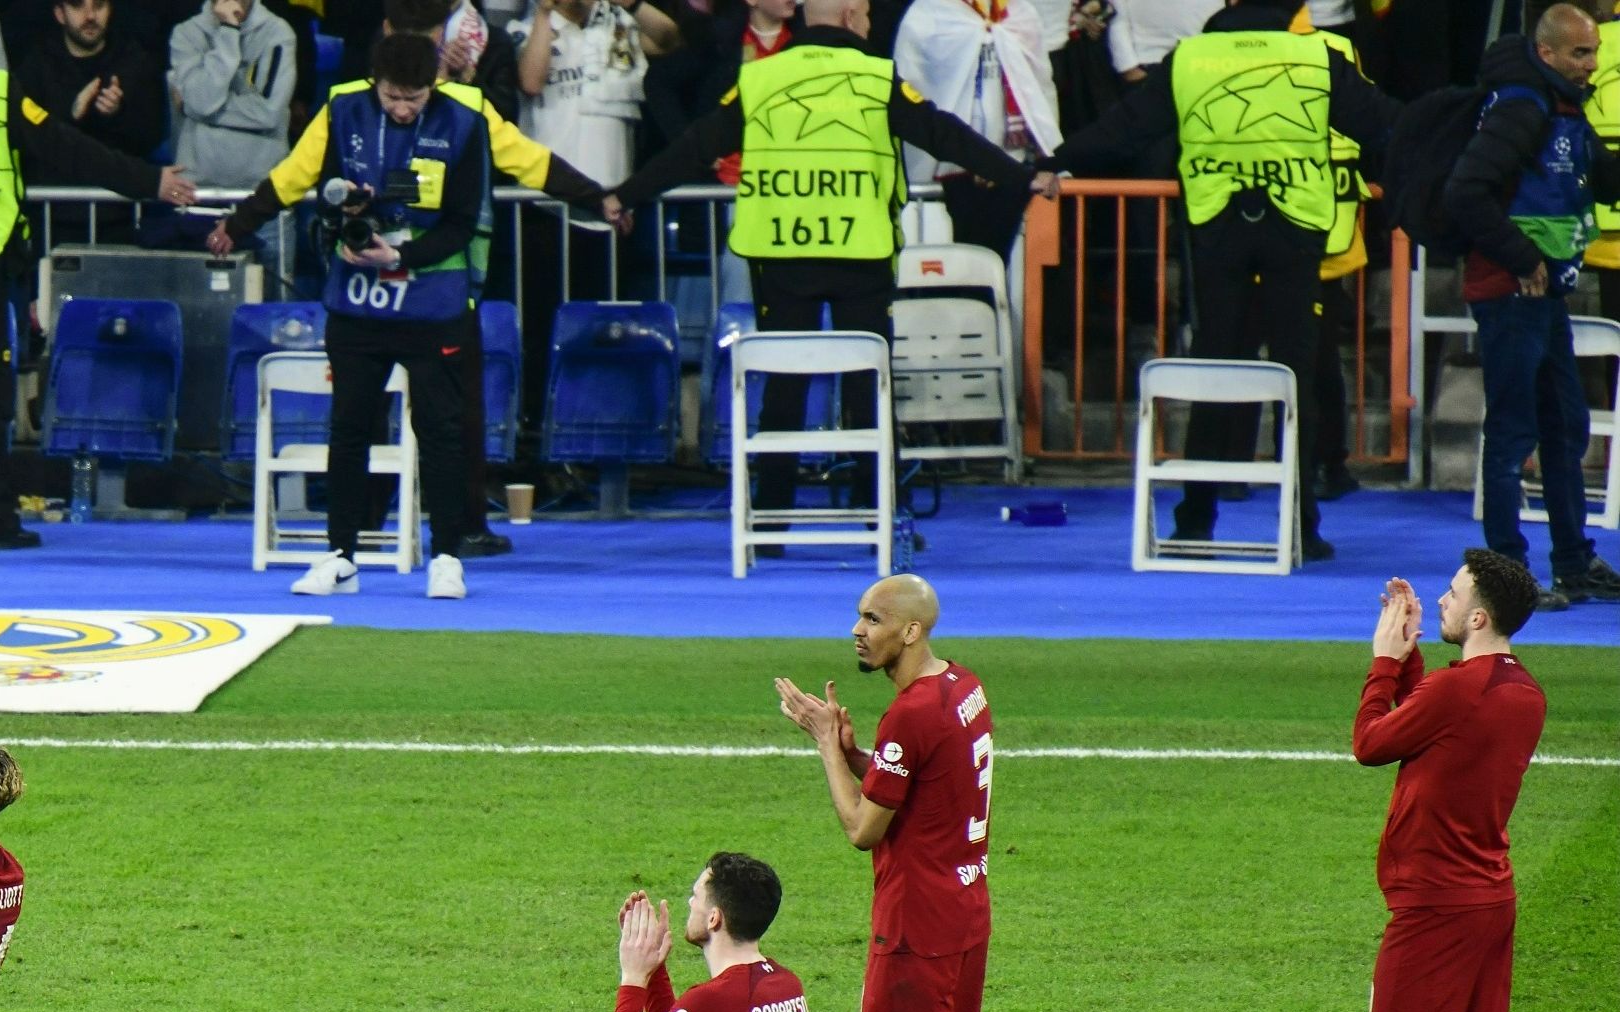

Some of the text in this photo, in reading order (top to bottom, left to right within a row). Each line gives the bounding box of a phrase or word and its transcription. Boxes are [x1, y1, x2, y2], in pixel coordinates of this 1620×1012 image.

[739, 169, 882, 199] SECURITY
[771, 216, 856, 246] 1617
[347, 272, 409, 312] 067
[968, 732, 994, 844] 3
